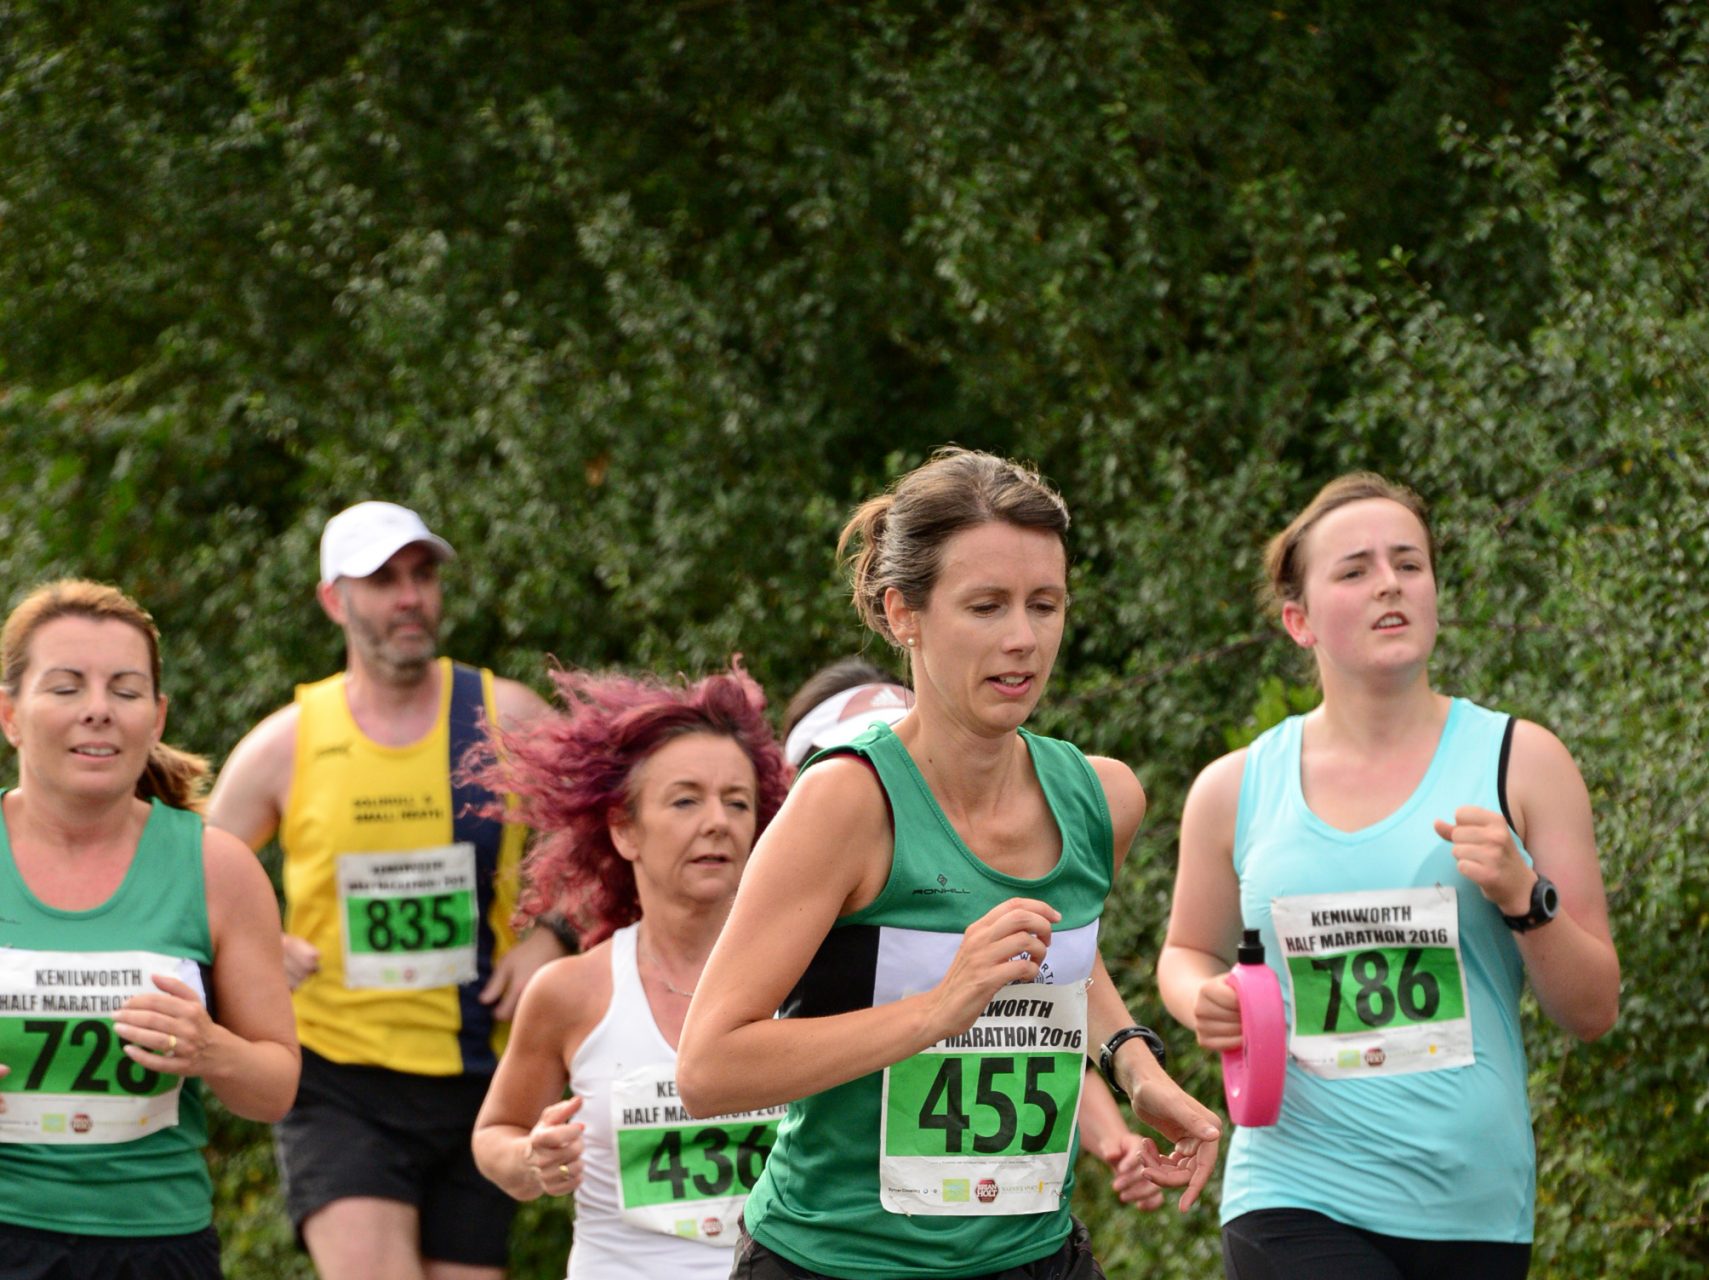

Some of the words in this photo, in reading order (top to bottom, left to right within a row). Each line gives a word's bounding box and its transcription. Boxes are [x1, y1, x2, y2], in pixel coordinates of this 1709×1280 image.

[366, 895, 458, 952] 835
[1311, 905, 1412, 927] KENILWORTH
[1285, 935, 1317, 952] HALF
[1320, 929, 1406, 949] MARATHON
[1409, 928, 1448, 944] 2016
[35, 969, 143, 987] KENILWORTH
[1311, 948, 1440, 1032] 786
[0, 994, 37, 1012] HALF
[43, 994, 133, 1012] MARATHO
[945, 1026, 1037, 1048] MARATHON
[1040, 1026, 1082, 1049] 2016
[24, 1019, 160, 1094] 728
[622, 1107, 659, 1125] HALF
[918, 1056, 1058, 1154] 455
[648, 1125, 772, 1200] 436
